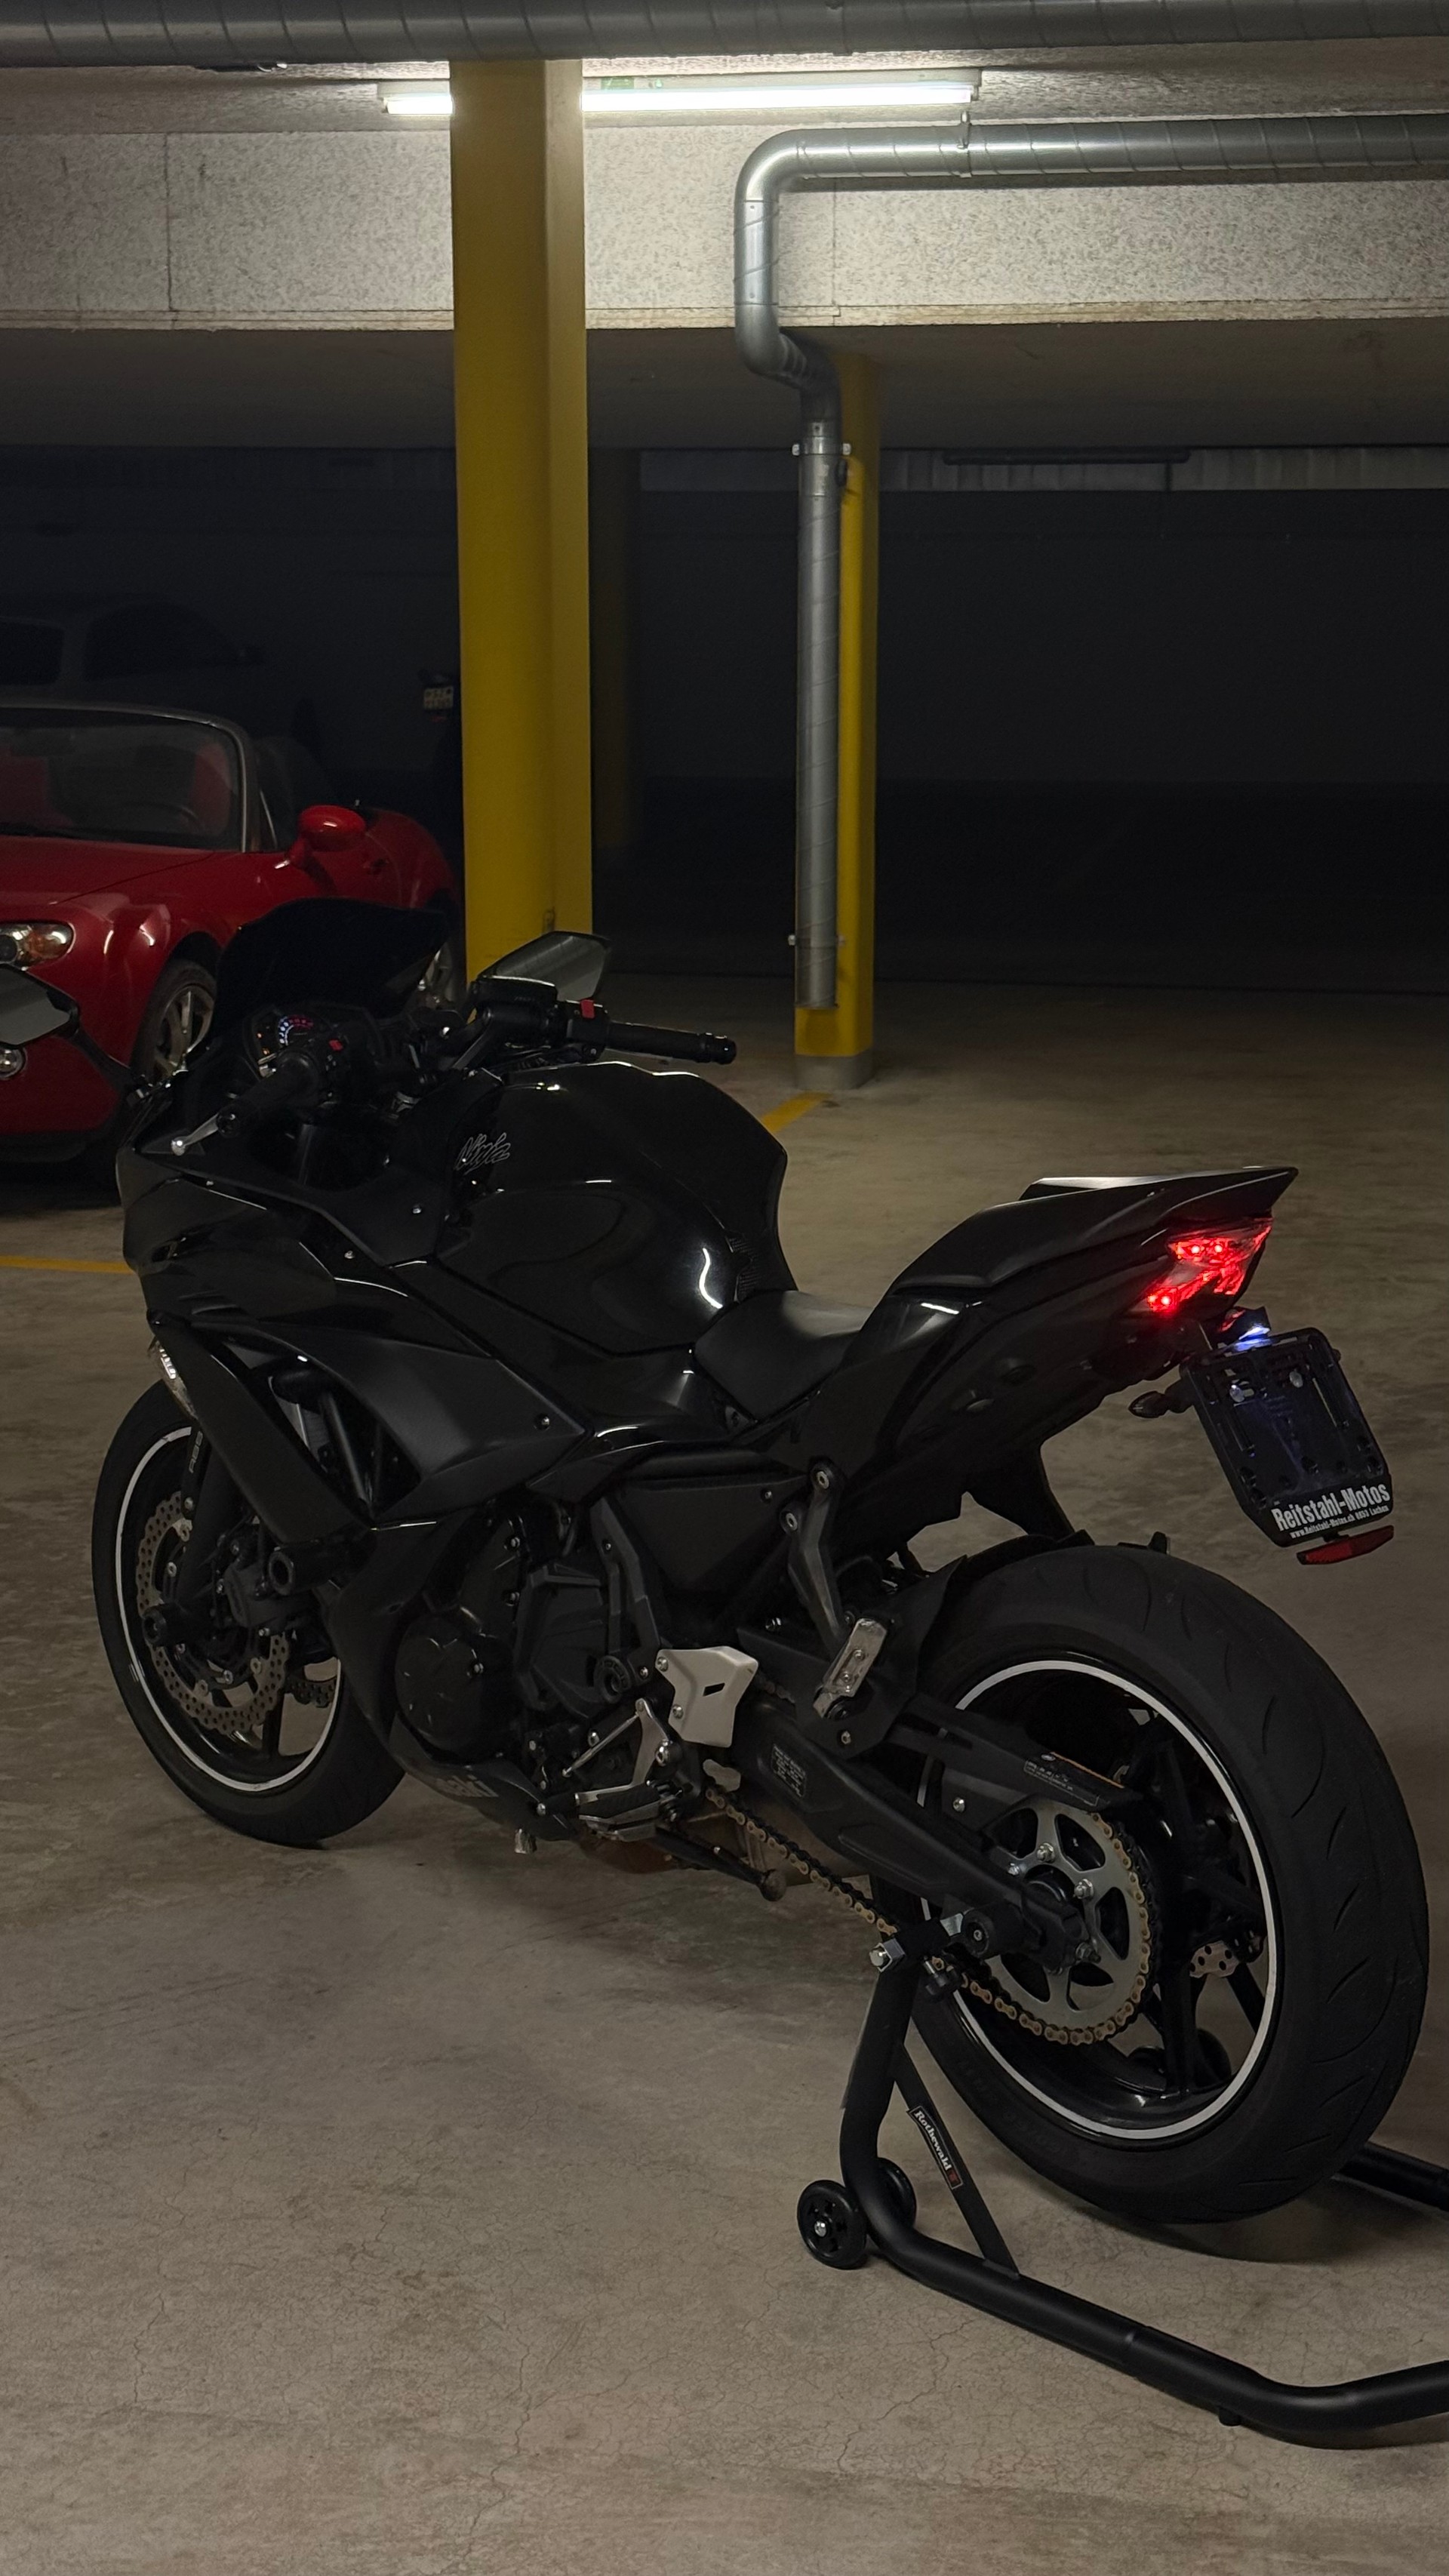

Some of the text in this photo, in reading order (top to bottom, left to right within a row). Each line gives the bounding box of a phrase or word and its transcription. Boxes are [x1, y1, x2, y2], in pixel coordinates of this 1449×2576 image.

[453, 1131, 511, 1176] Ninja
[1271, 1483, 1391, 1531] Reitstahl-Motos
[914, 2110, 952, 2171] Rothewald
